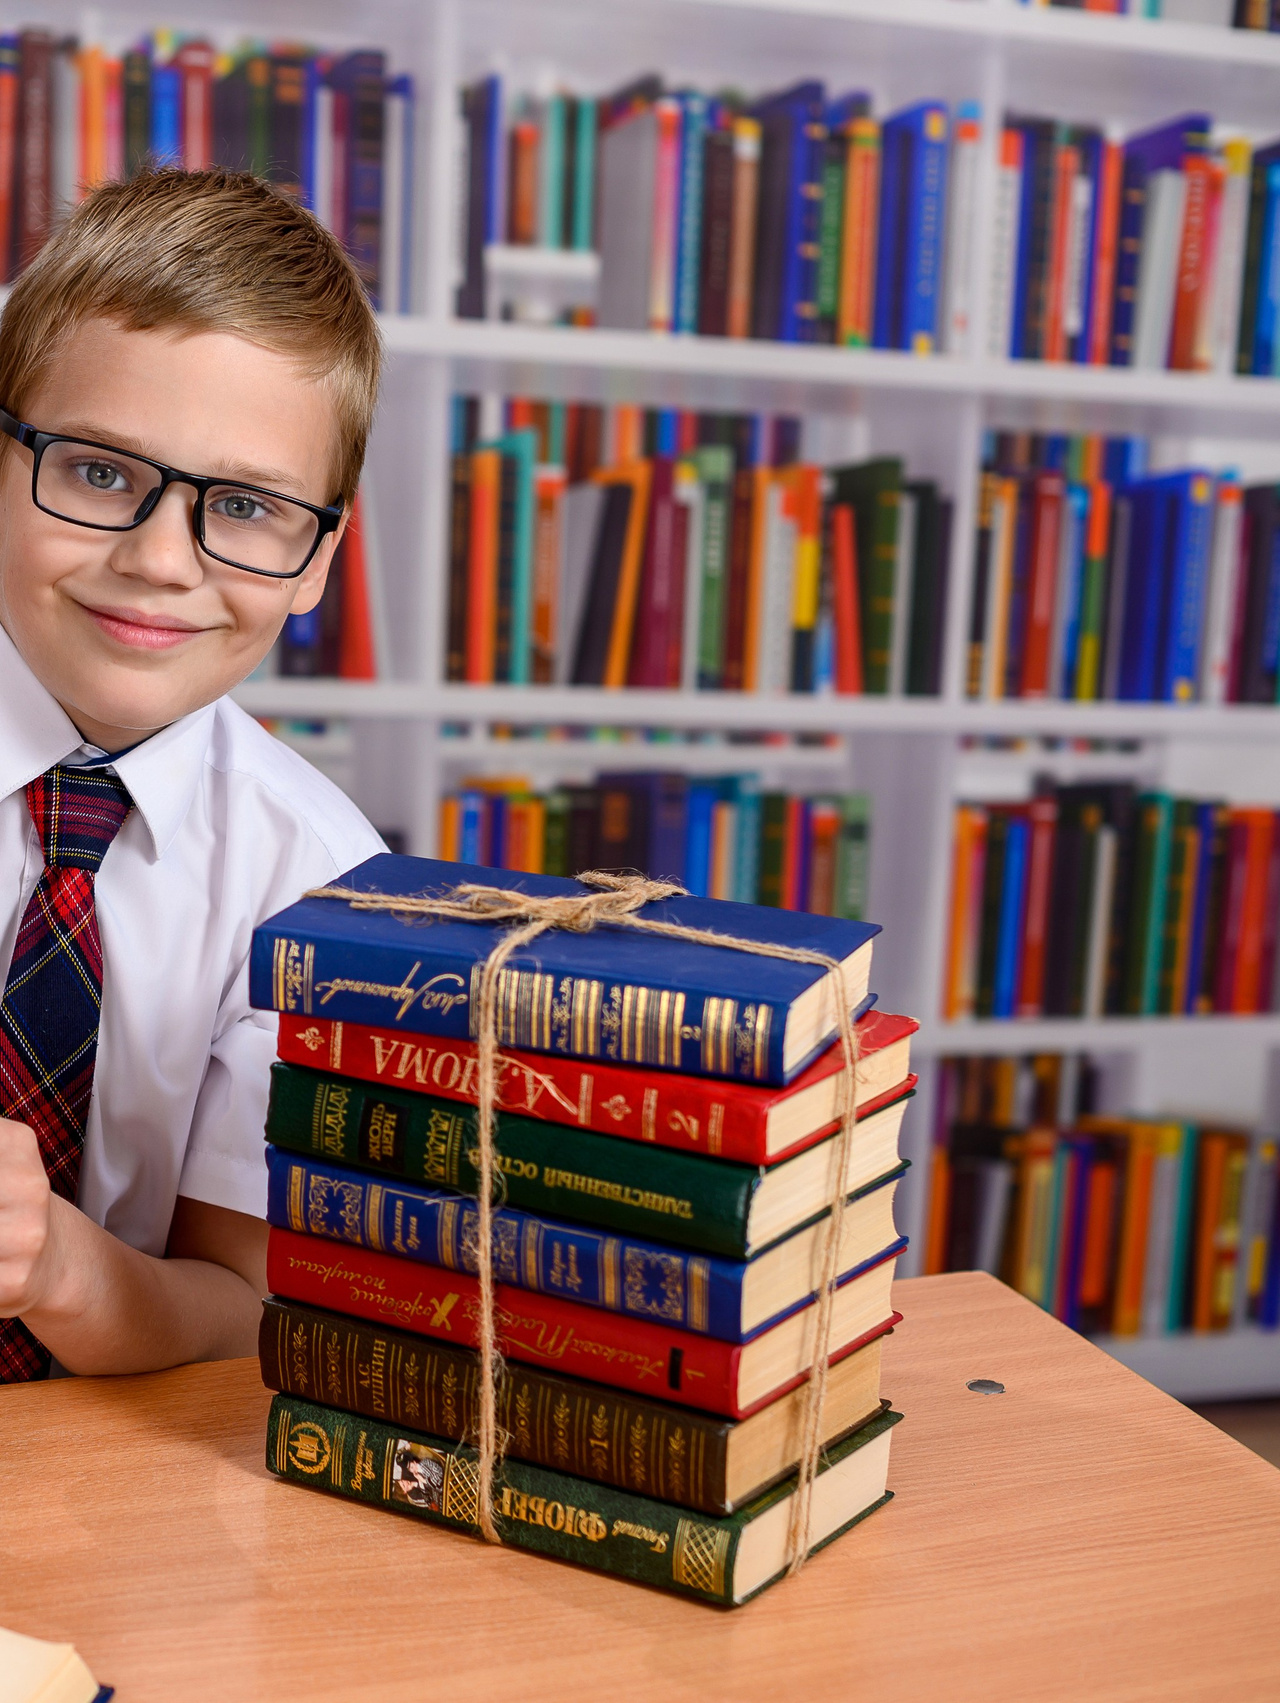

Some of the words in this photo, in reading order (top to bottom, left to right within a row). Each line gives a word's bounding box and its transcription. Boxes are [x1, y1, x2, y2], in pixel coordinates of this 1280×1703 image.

[680, 1025, 702, 1041] 2
[368, 1103, 386, 1161] ЖЮЛЬ
[382, 1112, 398, 1158] ВЕРН
[667, 1109, 700, 1141] 2
[468, 1149, 538, 1180] ОСТВ
[543, 1166, 694, 1220] ТАИНСТВЕННЫЙ
[287, 1256, 362, 1284] мукам
[363, 1274, 387, 1291] по
[349, 1285, 460, 1332] Хождение
[573, 1337, 665, 1380] Алексей
[685, 1366, 706, 1381] 1
[588, 1438, 609, 1450] 1
[494, 1486, 608, 1543] ФЛОБЕР
